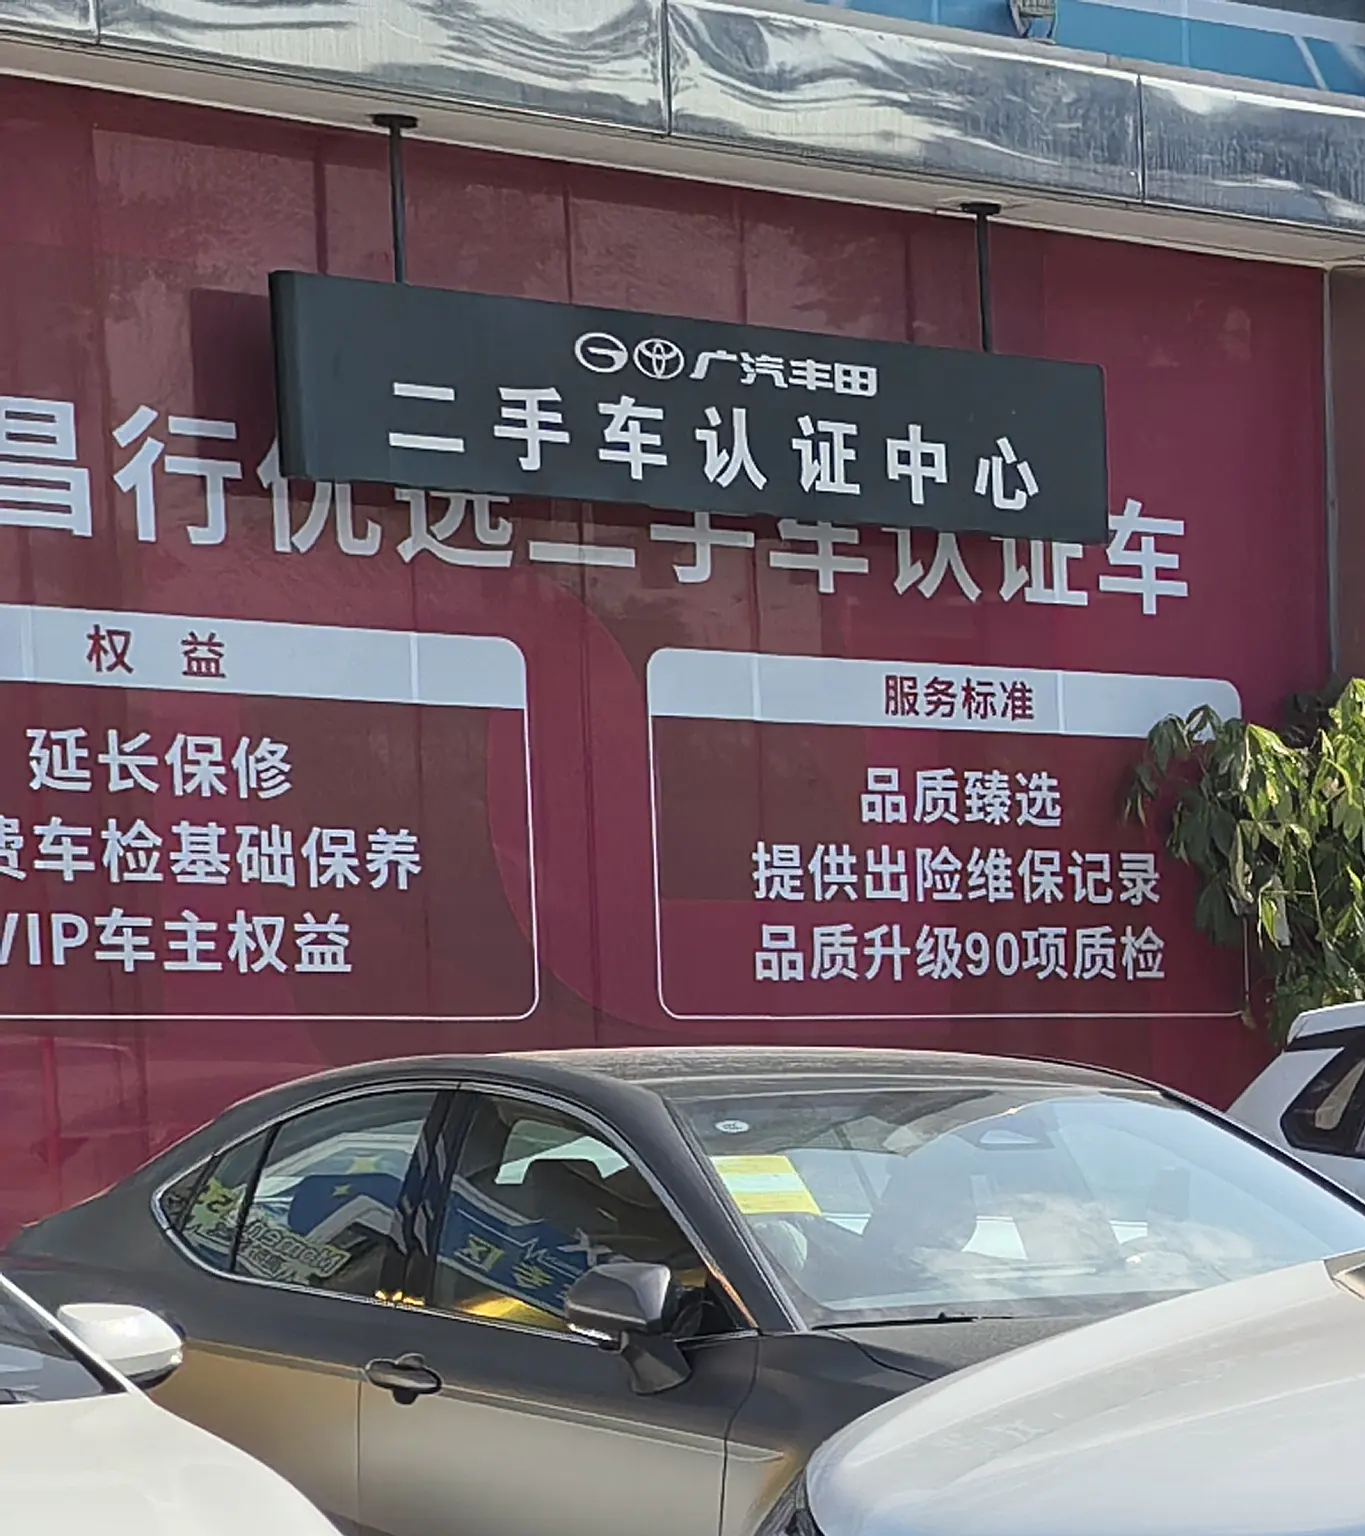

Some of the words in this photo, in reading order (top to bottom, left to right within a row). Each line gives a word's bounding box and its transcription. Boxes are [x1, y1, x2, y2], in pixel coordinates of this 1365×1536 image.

[689, 350, 878, 397] 广汽丰田
[388, 381, 1040, 511] 二手车认证中心
[86, 623, 227, 679] 权益
[883, 673, 1036, 722] 服务标准
[26, 727, 293, 800] 延长保修
[860, 766, 1063, 828] 品质臻选
[751, 841, 1161, 906] 提供出险维保记录
[754, 923, 1166, 982] 品质升级90项质检
